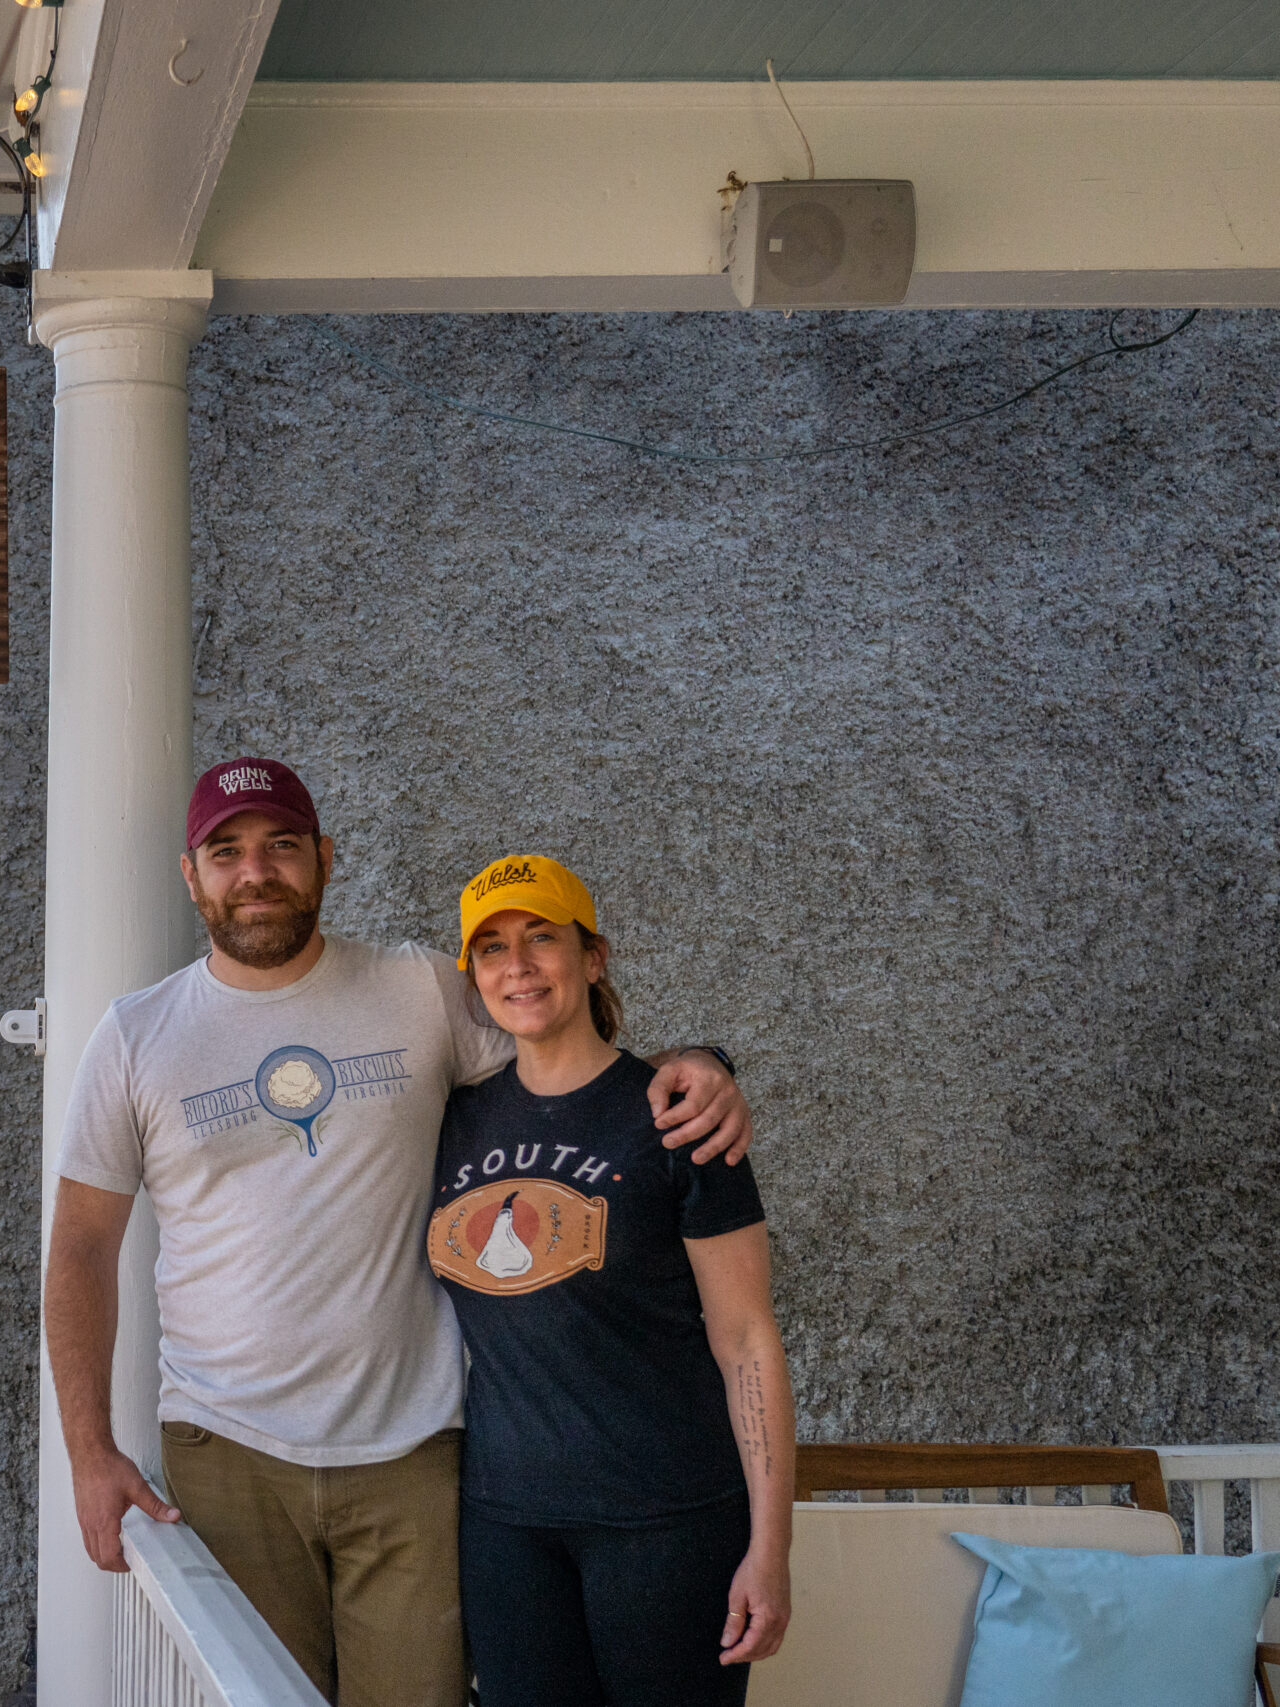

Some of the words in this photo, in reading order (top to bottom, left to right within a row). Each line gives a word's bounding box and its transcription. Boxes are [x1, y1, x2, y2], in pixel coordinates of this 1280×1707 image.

[218, 766, 273, 787] DRINK
[222, 777, 273, 795] WELL
[471, 862, 536, 901] Walsh
[183, 1084, 253, 1126] BUFORD'S
[337, 1053, 405, 1085] BISCUITS
[193, 1109, 257, 1140] LEESBURG
[344, 1081, 405, 1100] VIRGINIA
[453, 1143, 609, 1189] SOUTH
